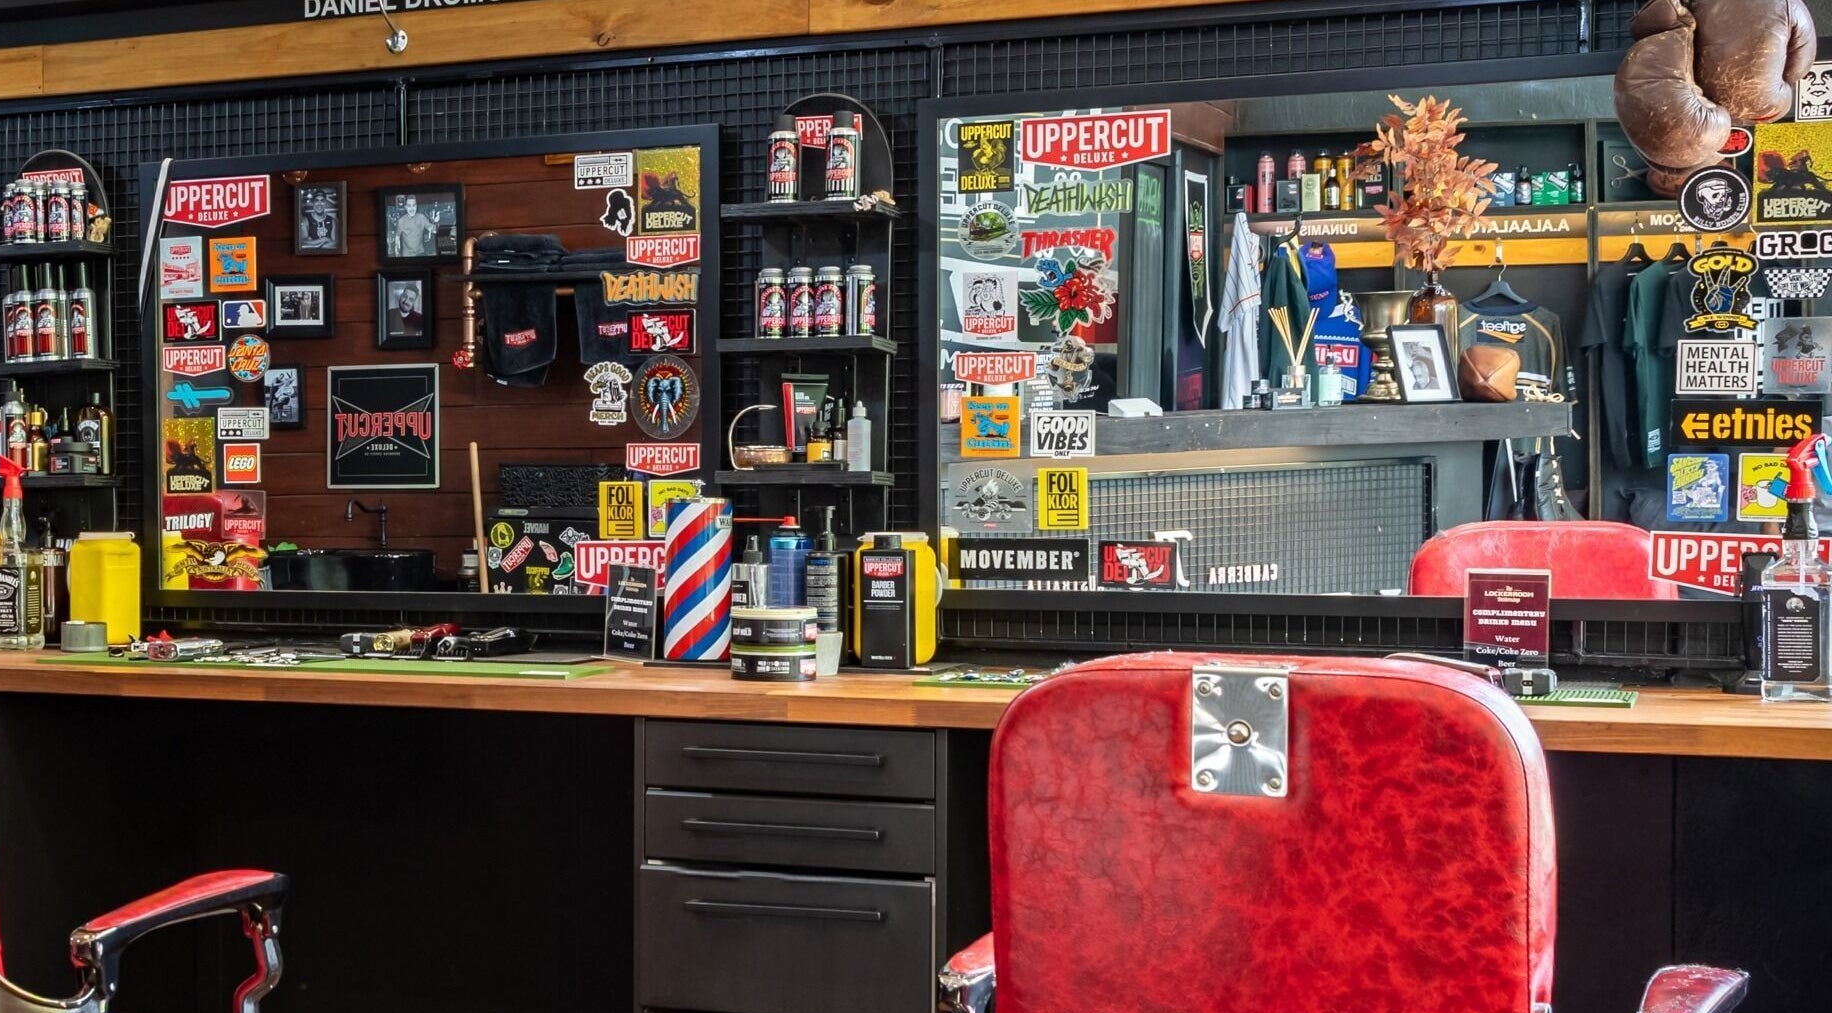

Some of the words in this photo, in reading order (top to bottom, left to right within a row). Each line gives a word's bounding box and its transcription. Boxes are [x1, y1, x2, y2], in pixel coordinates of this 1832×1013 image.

[1801, 104, 1832, 117] OBEY
[960, 123, 1012, 142] UPPERCUT
[1026, 116, 1164, 159] UPPERCUT
[1073, 151, 1115, 164] DELUXE
[580, 165, 625, 177] UPPERCUT
[960, 174, 997, 191] DELUXE
[165, 181, 265, 216] UPPERCUT
[1023, 181, 1132, 215] DEATHWISH
[1763, 197, 1832, 214] UPPERCUT
[1763, 206, 1818, 218] DELUXE
[198, 211, 229, 222] DELUXE
[645, 211, 693, 225] UPPERCUT
[961, 203, 992, 229] UPPERCUT
[993, 204, 1016, 226] DELUXE
[645, 218, 684, 229] DELUXE
[630, 237, 697, 260] UPPERCUT
[1020, 228, 1117, 263] THRASHER
[1693, 255, 1753, 273] GOLD
[603, 272, 697, 302] DEATHWISH
[965, 316, 1014, 330] UPPERCUT
[166, 348, 222, 368] UPPERCUT
[228, 343, 267, 359] SANTA
[1687, 347, 1749, 359] MENTAL
[230, 357, 263, 373] CRUZ
[958, 355, 1034, 378] UPPERCUT
[1685, 360, 1749, 373] HEALTH
[1771, 359, 1825, 372] UPPERCUT
[983, 374, 1007, 382] DELUXE
[1685, 375, 1748, 388] MATTERS
[591, 411, 624, 420] MERCH
[221, 418, 263, 429] UPPERCUT
[1037, 415, 1089, 435] GOOD
[1712, 407, 1813, 440] etnies
[1037, 433, 1089, 451] VIBES
[227, 454, 256, 471] LEGO
[630, 446, 696, 467] UPPERCUT
[1752, 464, 1762, 472] NO
[170, 475, 210, 487] UPPERCUT
[170, 482, 203, 491] DELUXE
[959, 468, 994, 493] UPPERCUT
[996, 468, 1023, 492] DELUXE
[1048, 472, 1076, 493] FOL
[608, 485, 633, 505] FOL
[1048, 493, 1078, 510] KLOR
[607, 506, 634, 520] KLOR
[165, 512, 214, 531] TRILOGY
[224, 519, 262, 531] UPPERCUT
[864, 563, 903, 575] UPPERCUT
[871, 580, 896, 589] BARBER
[871, 588, 896, 598] POWDER
[623, 619, 638, 628] Water
[1494, 635, 1521, 643] Water
[1476, 647, 1519, 656] Coke/Coke
[1520, 648, 1539, 656] Zero
[1498, 660, 1516, 668] Beer
